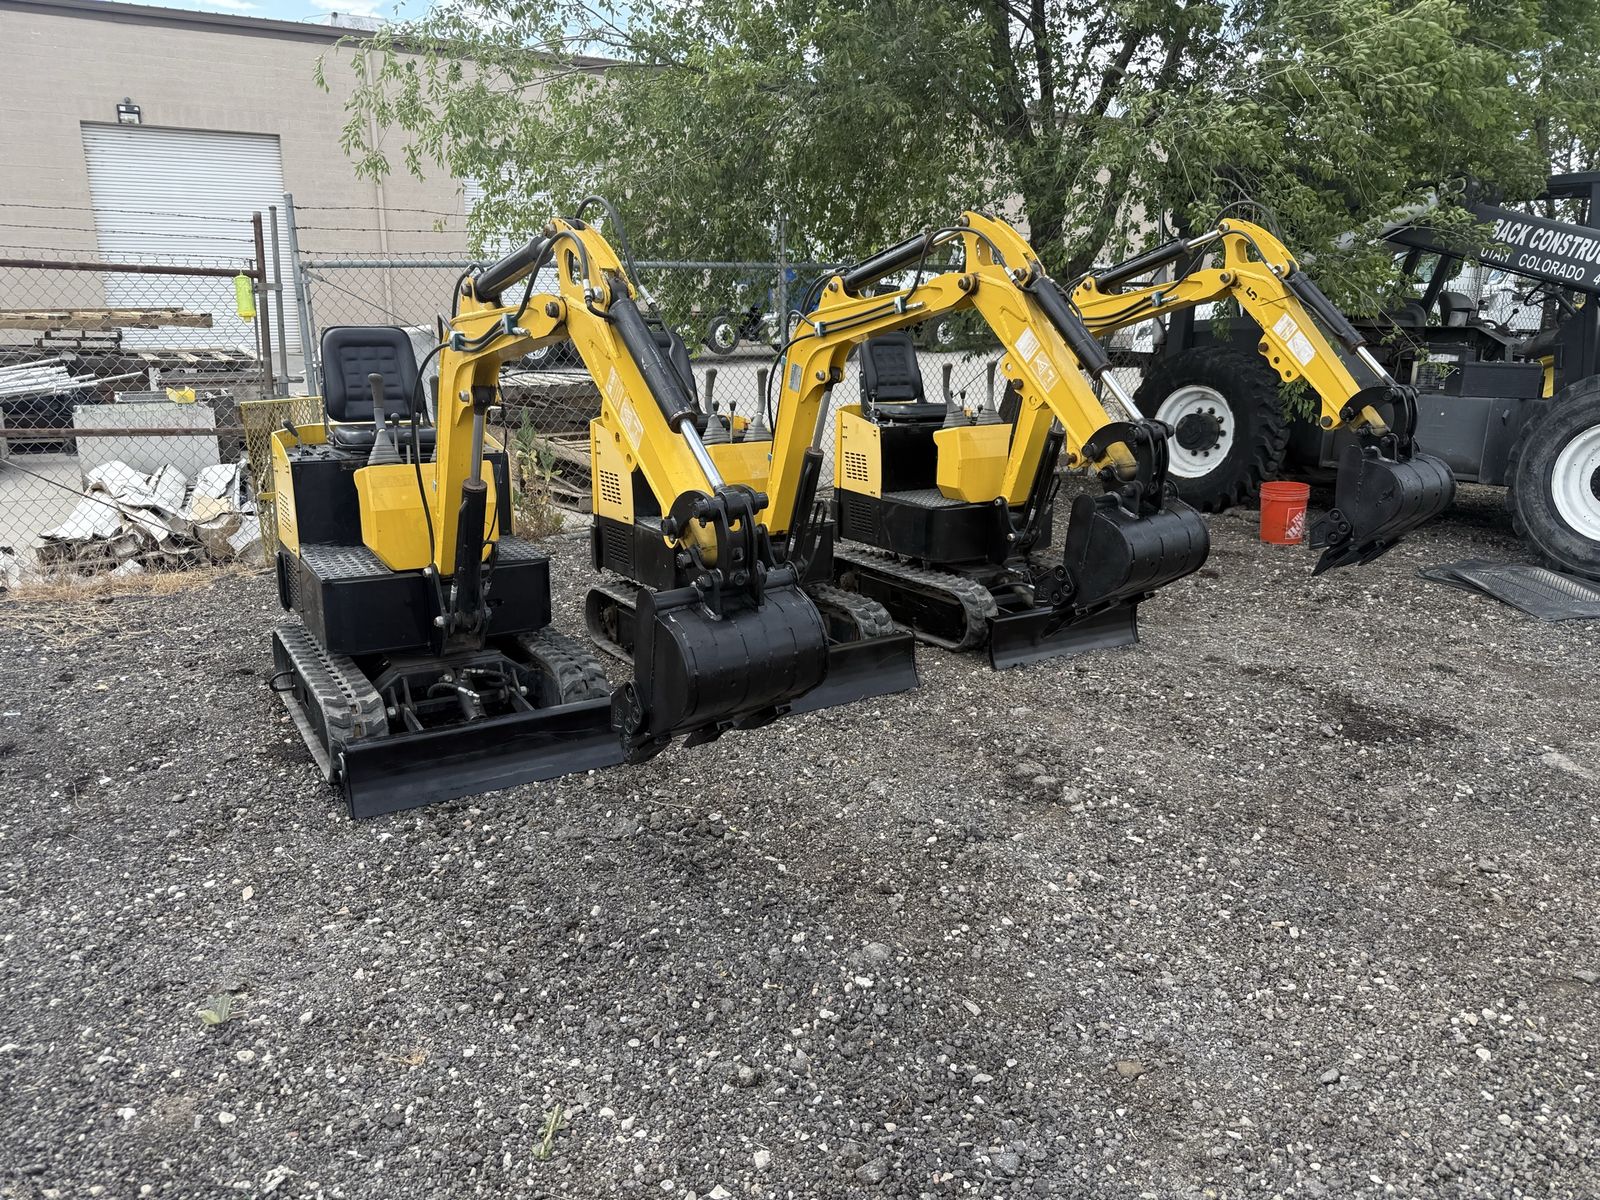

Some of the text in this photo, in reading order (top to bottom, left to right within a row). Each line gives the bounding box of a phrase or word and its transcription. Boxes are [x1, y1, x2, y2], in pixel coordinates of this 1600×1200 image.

[1492, 218, 1600, 264] BACK CONSTRU
[1481, 247, 1510, 263] UTAH
[1519, 254, 1585, 281] COLORADO
[1246, 287, 1257, 300] 5
